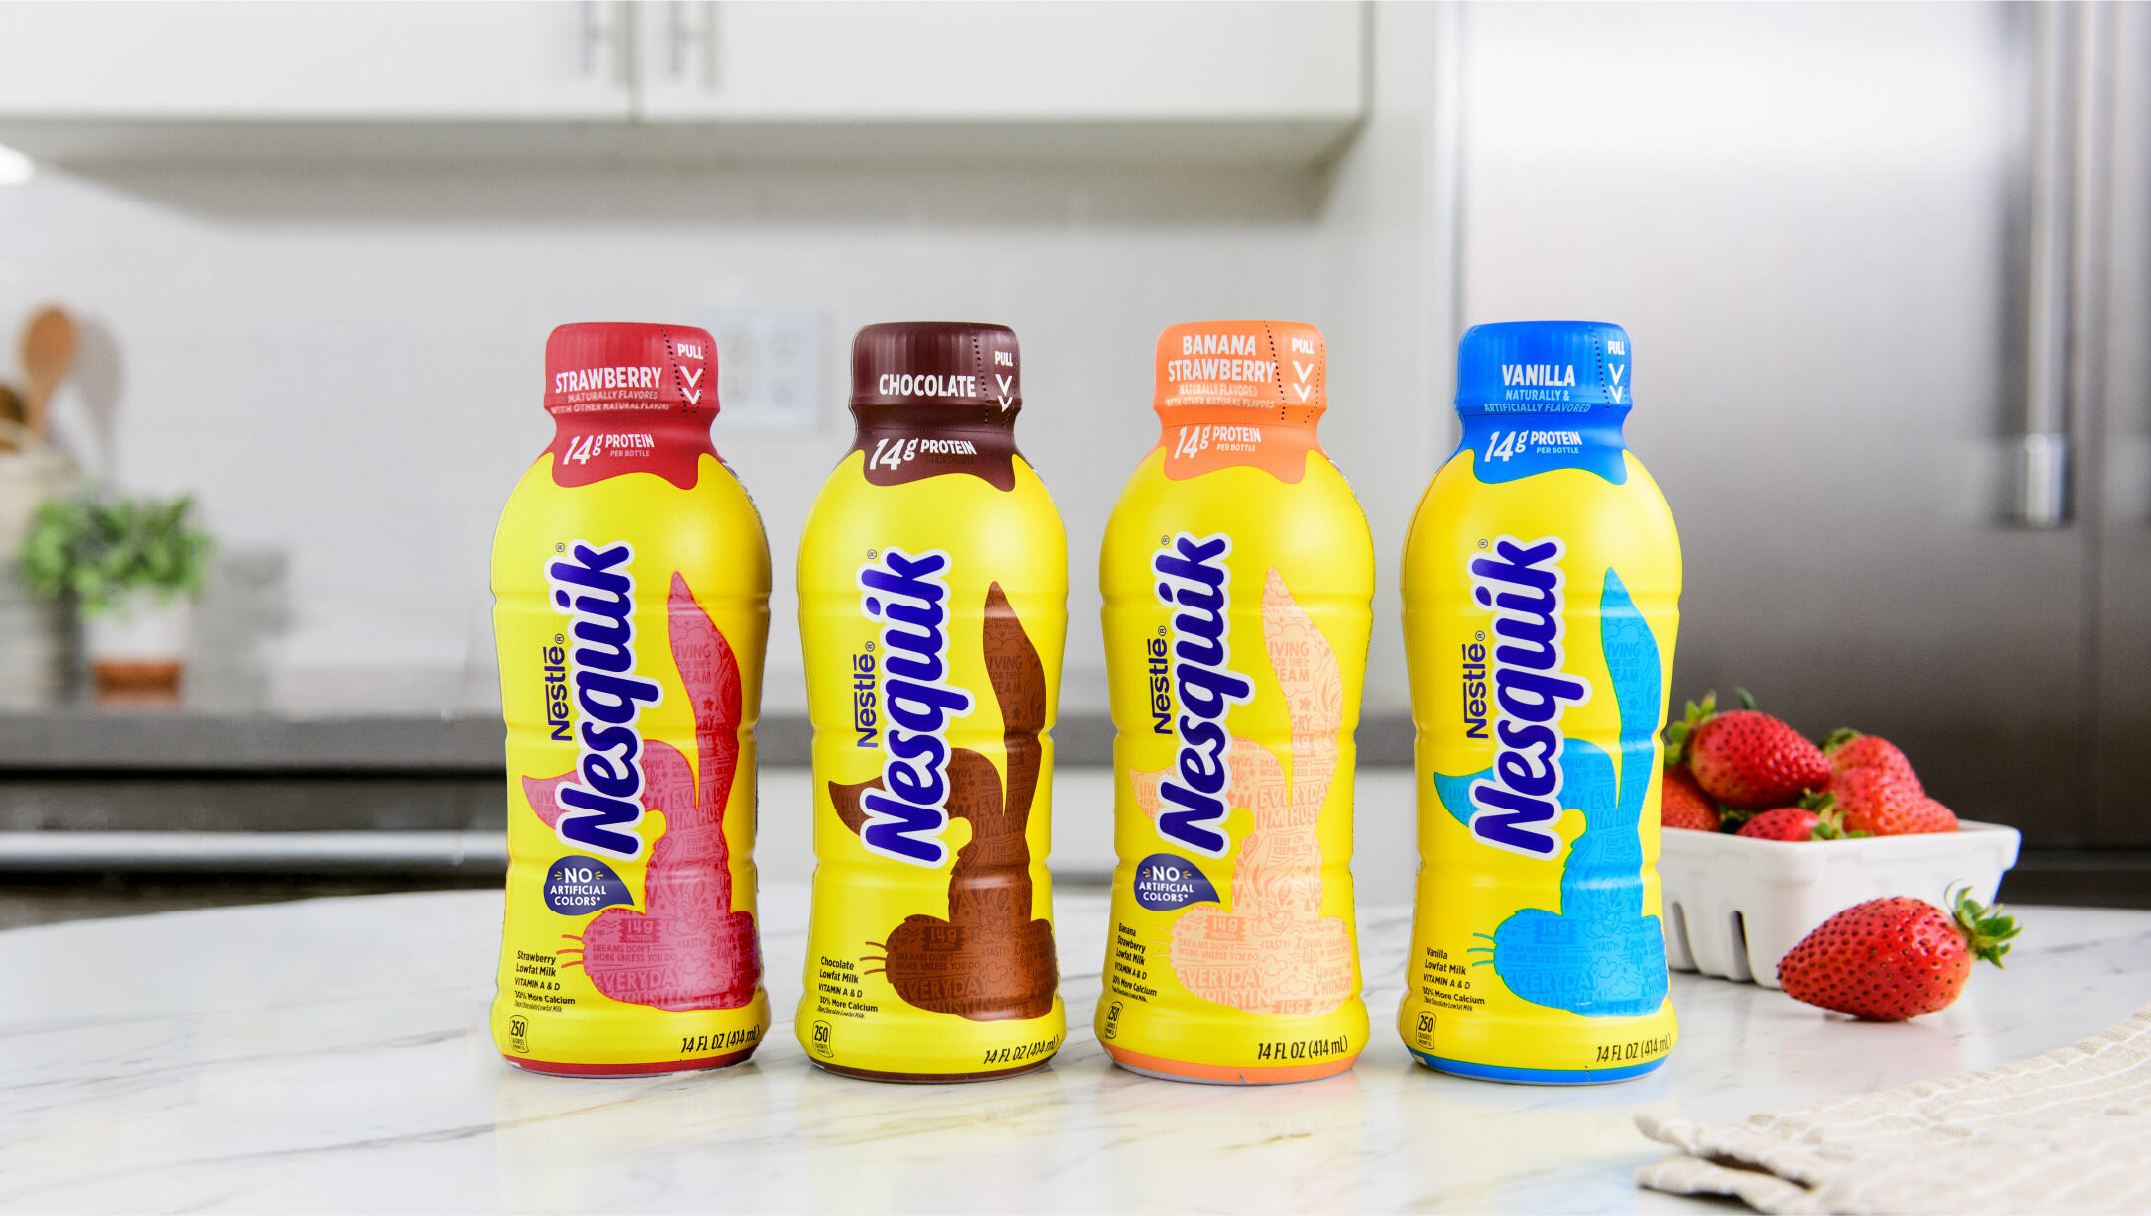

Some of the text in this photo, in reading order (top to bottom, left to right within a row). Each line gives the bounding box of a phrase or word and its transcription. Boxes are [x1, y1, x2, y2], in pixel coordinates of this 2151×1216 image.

[677, 343, 703, 360] PULL
[1183, 335, 1256, 356] BANANA
[1292, 338, 1314, 354] PULL
[1607, 340, 1625, 355] PULL
[994, 351, 1013, 367] PULL
[1168, 359, 1277, 383] STRAWBERRY
[1502, 365, 1575, 387] VANILLA
[555, 367, 662, 393] STRAWBERRY
[879, 374, 976, 397] CHOCOLATE
[568, 390, 659, 403] NATURALLY FLAVORED
[1179, 384, 1258, 397] NATURALLY FLAVORED
[1505, 390, 1569, 401] NATURALLY &
[1183, 397, 1204, 406] OTHER
[1206, 397, 1241, 407] NATURAL
[1484, 404, 1591, 413] ARTIFICIALLY FLAVORED
[605, 434, 655, 449] PROTEIN
[1212, 426, 1262, 443] PROTEIN
[1530, 432, 1583, 446] PROTEIN
[610, 450, 651, 458] PER BOTTLE
[920, 439, 978, 455] PROTEIN
[1217, 443, 1256, 452] PER BOTTLE
[1537, 446, 1580, 454] PER BOTTLE
[1270, 641, 1310, 657] IVING
[550, 544, 659, 855] Nesquik
[1155, 537, 1250, 853] Nesquik
[1471, 540, 1584, 855] Nesquik
[861, 552, 969, 863] Nesquik
[564, 868, 592, 884] NO
[1152, 866, 1180, 882] NO
[550, 886, 607, 896] ARTIFICIAL
[1138, 882, 1194, 894] ARTIFICIAL
[1118, 922, 1136, 937] Banana
[1117, 934, 1146, 954] Strawberry
[517, 950, 556, 966] Strawberry
[1116, 947, 1145, 966] Lowfat Milk
[1426, 946, 1448, 960] Vanilla
[516, 962, 557, 977] Lowfat Milk
[820, 956, 854, 970] Chocolate
[1114, 962, 1147, 980] VITAMIN A & D
[1424, 959, 1466, 975] Lowfat Milk
[514, 977, 561, 991] VITAMIN A & D
[820, 968, 859, 984] Lowfat Milk
[1424, 972, 1471, 990] VITAMIN A & D
[818, 982, 863, 998] VITAMIN A & D
[1121, 978, 1133, 990] More
[1133, 982, 1158, 997] Calcium
[528, 992, 543, 1002] More
[544, 995, 576, 1005] Calcium
[820, 996, 831, 1006] 30%
[832, 998, 847, 1009] More
[848, 1002, 879, 1013] Calcium
[1435, 990, 1452, 1000] More
[1454, 994, 1485, 1005] Calcium
[511, 1020, 526, 1038] 250
[1418, 1014, 1434, 1033] 250
[681, 1037, 694, 1053] 14
[696, 1035, 708, 1052] FL
[712, 1034, 725, 1051] OZ
[726, 1028, 745, 1049] (414
[814, 1025, 829, 1043] 250
[983, 1050, 997, 1064] 14
[998, 1048, 1011, 1063] FL
[1012, 1046, 1026, 1062] OZ
[1026, 1040, 1045, 1060] (414
[1257, 1042, 1271, 1060] 14
[1274, 1042, 1288, 1060] FL
[1291, 1041, 1305, 1059] OZ
[1308, 1038, 1329, 1059] (414
[1596, 1045, 1609, 1063] 14
[1612, 1044, 1623, 1061] FL
[1625, 1042, 1639, 1060] OZ
[1640, 1038, 1659, 1059] (414
